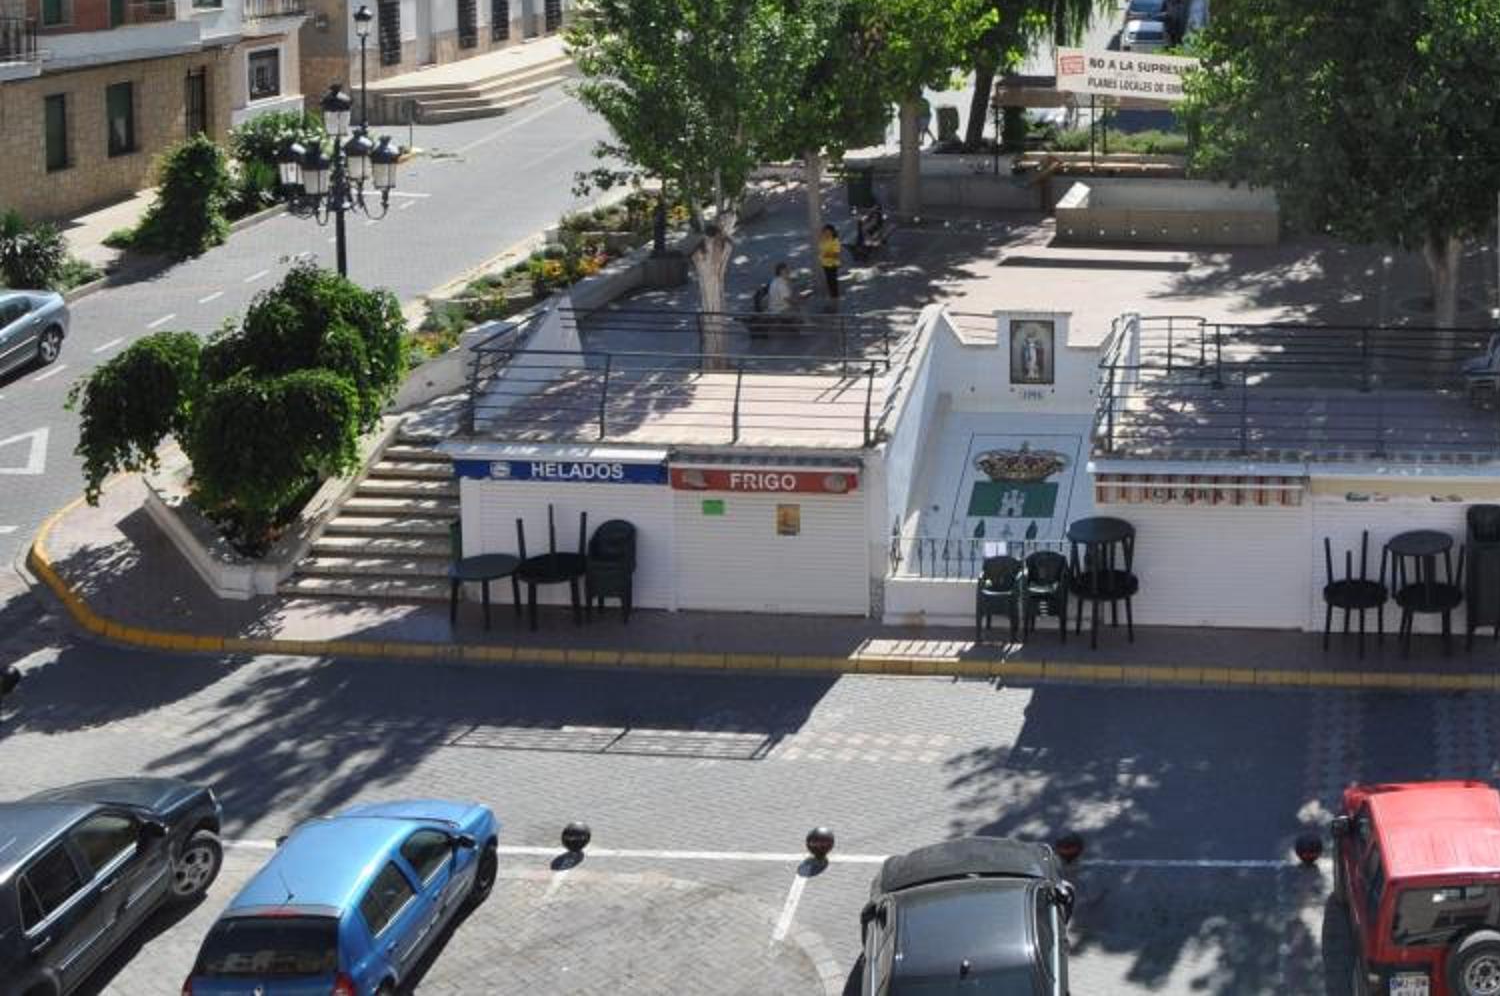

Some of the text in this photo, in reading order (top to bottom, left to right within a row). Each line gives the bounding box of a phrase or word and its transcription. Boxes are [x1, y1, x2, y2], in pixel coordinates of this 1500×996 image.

[1089, 57, 1105, 69] NO
[1108, 59, 1116, 70] A
[1120, 60, 1133, 71] LA
[1088, 77, 1117, 89] PLANES
[1120, 79, 1152, 91] LOCALES
[1154, 81, 1164, 92] DE
[531, 462, 624, 480] HELADOS
[729, 472, 797, 491] FRIGO
